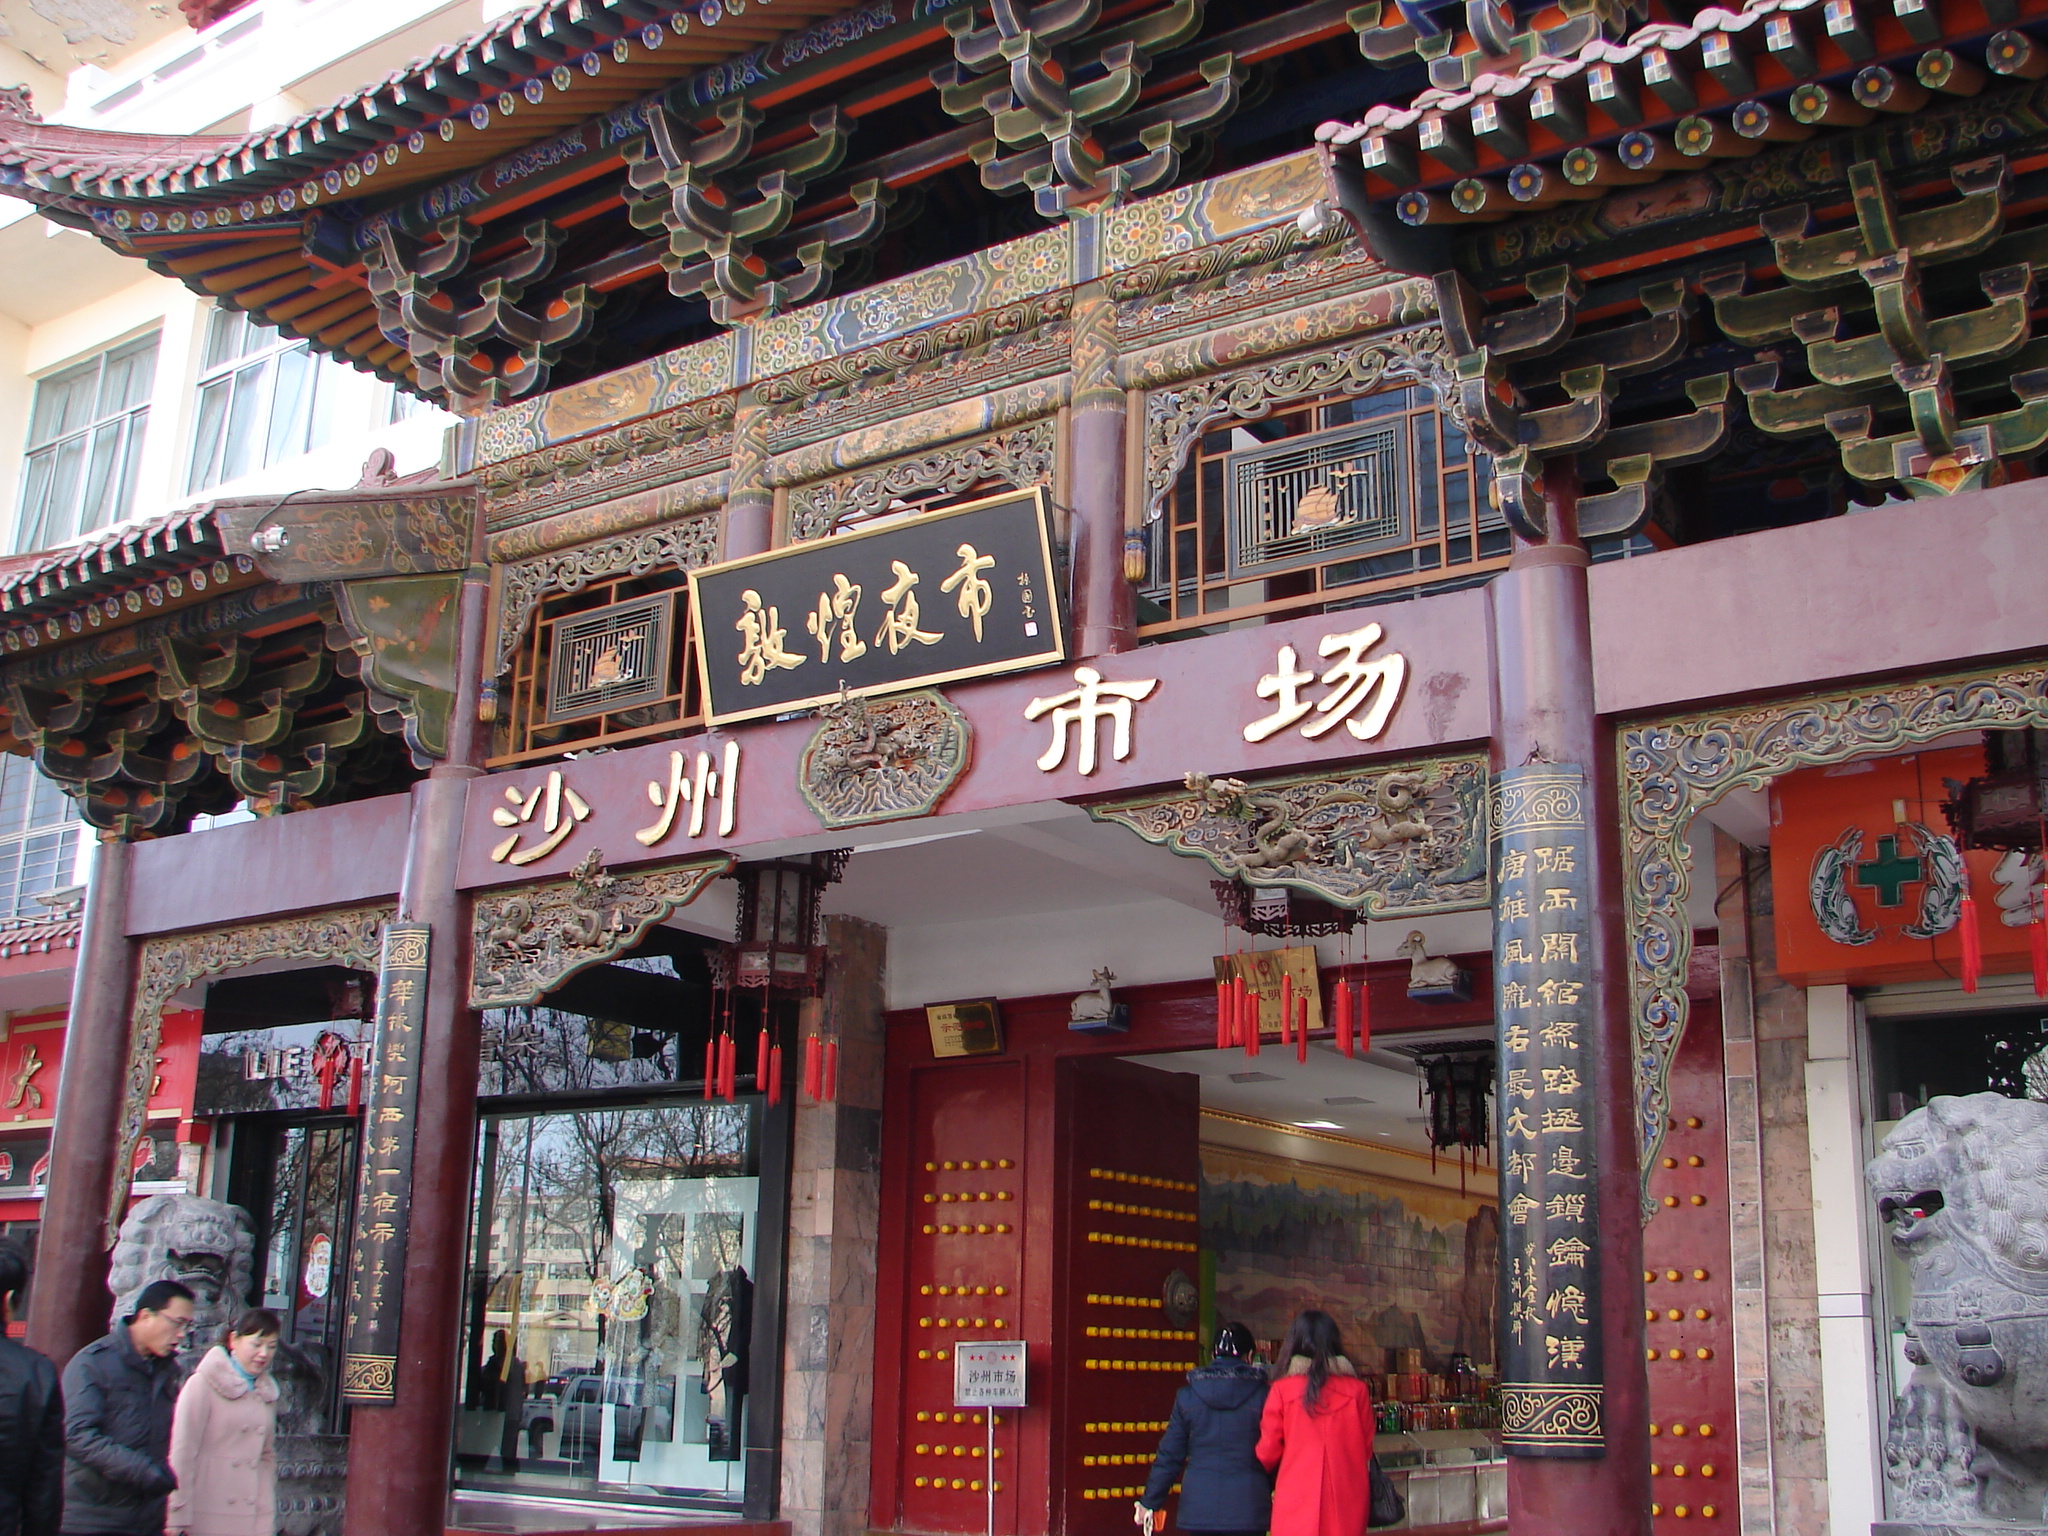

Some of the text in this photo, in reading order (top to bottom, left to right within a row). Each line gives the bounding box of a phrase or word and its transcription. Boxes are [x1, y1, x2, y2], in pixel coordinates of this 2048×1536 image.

[735, 542, 996, 686] 敦煌夜市
[491, 622, 1407, 866] 沙州市场
[968, 1369, 1017, 1384] 沙州市场
